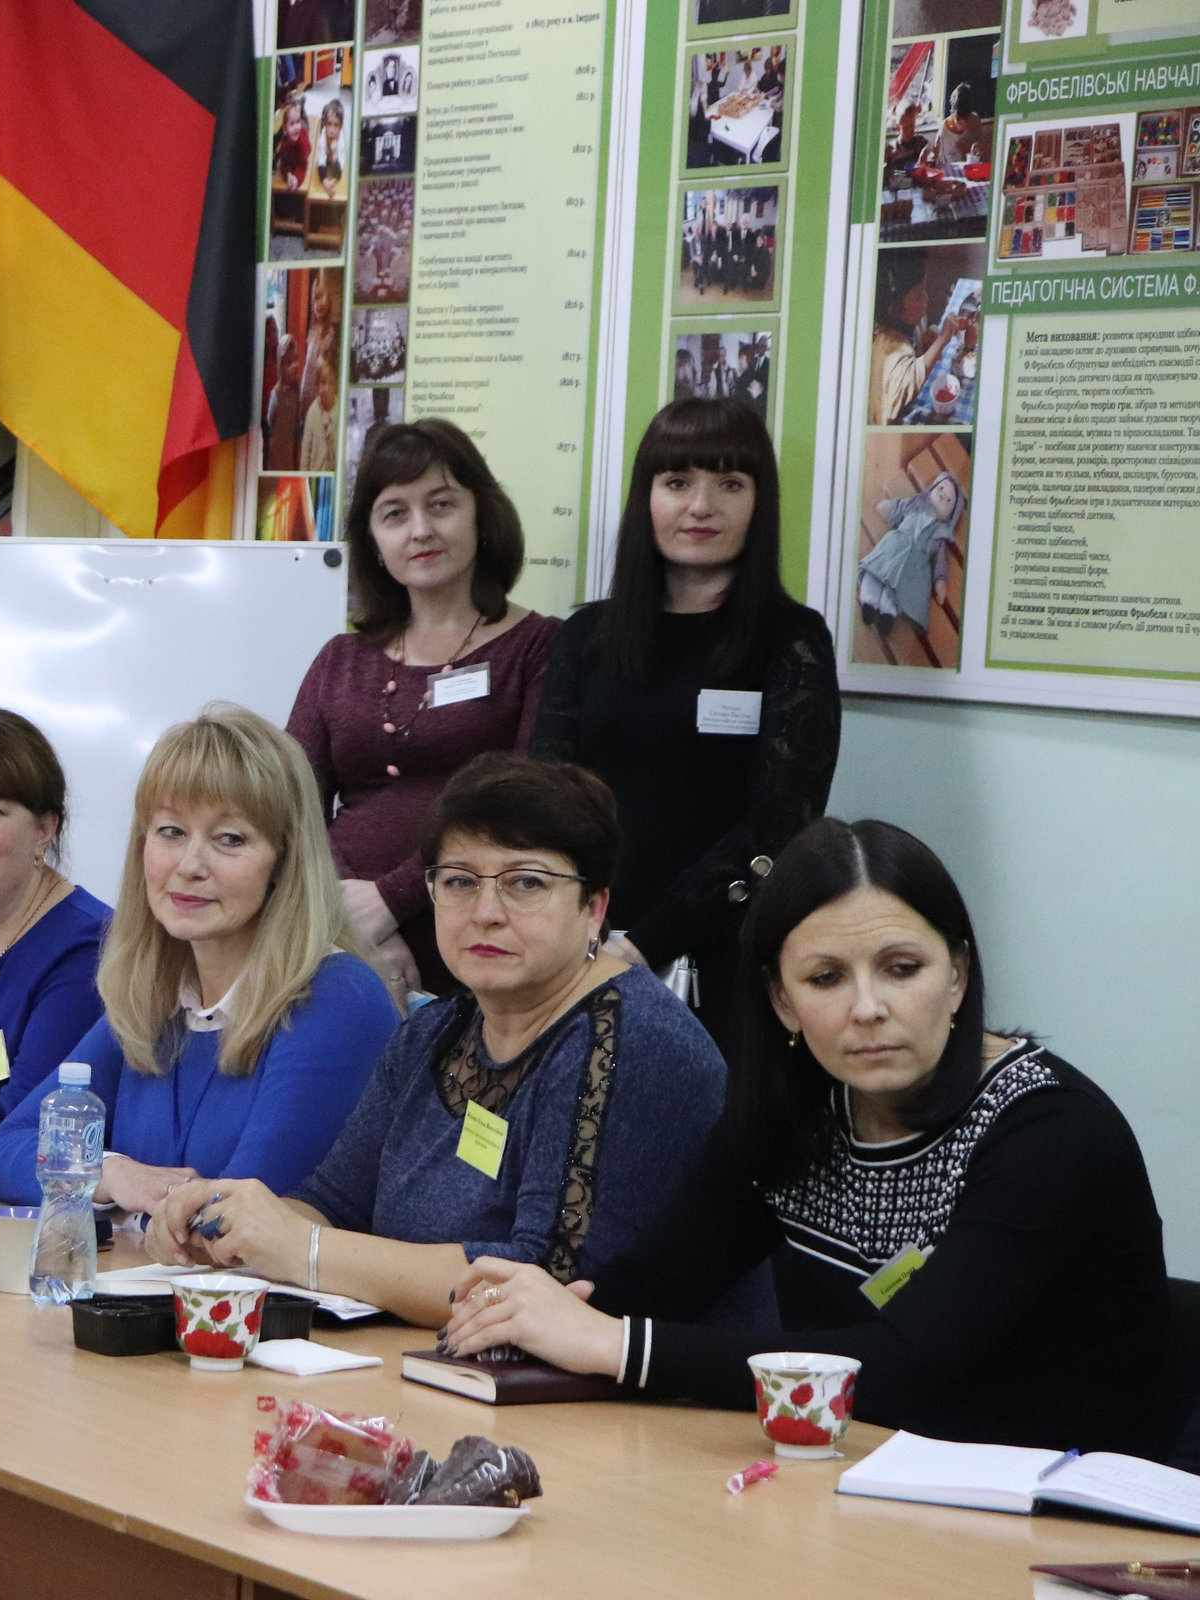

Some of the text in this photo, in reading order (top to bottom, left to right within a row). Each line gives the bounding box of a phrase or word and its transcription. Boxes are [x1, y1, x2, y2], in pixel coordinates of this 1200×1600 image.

[1006, 70, 1130, 105] ФРЬОБЕЛІВСЬКІ
[991, 272, 1199, 307] ПЕДАГОГІЧНА СИСТЕМА Ф.
[1026, 331, 1049, 342] Мета
[1050, 332, 1100, 342] виховання:
[1129, 608, 1167, 620] Фрьобеля
